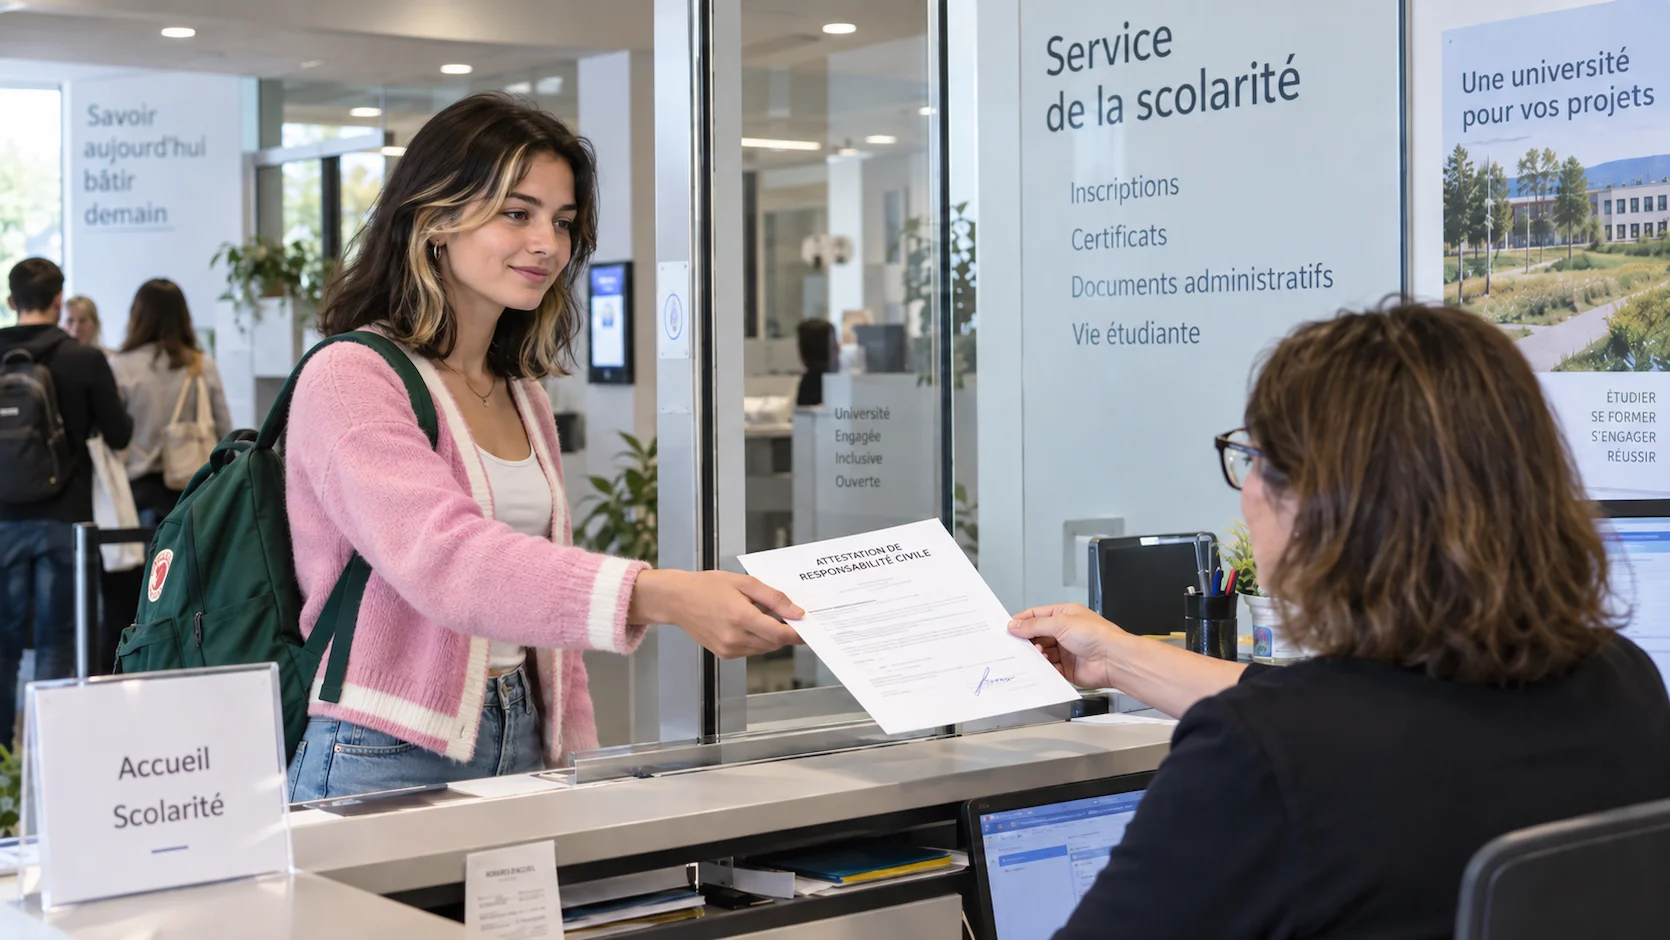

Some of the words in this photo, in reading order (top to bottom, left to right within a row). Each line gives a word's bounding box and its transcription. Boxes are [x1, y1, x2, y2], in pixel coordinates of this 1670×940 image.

[1046, 20, 1173, 77] Service
[1462, 70, 1504, 94] Une
[1512, 46, 1630, 87] université
[1046, 90, 1085, 133] de
[1097, 84, 1124, 127] la
[1136, 53, 1301, 121] scolarité
[86, 101, 158, 127] Savoir
[1463, 104, 1514, 133] pour
[1520, 99, 1560, 121] vos
[1567, 85, 1655, 121] projets
[83, 134, 207, 165] aujourd'hui
[83, 168, 137, 193] bâtir
[1070, 174, 1180, 207] Inscriptions
[83, 201, 169, 226] demain
[1071, 224, 1168, 252] Certificats
[1071, 272, 1179, 299] Documents
[1184, 262, 1334, 295] administratifs
[1072, 322, 1101, 346] Vie
[1106, 320, 1201, 346] étudiante
[1606, 388, 1656, 404] ÉTUDIER
[834, 405, 891, 421] Université
[1591, 410, 1605, 423] SE
[1608, 410, 1656, 424] FORMER
[835, 428, 882, 446] Engagée
[1591, 430, 1656, 443] S'ENGAGER
[835, 451, 884, 465] Inclusive
[1607, 447, 1656, 464] RÉUSSIR
[835, 474, 881, 488] Ouverte
[799, 554, 894, 582] RESPONSABILITÉ
[895, 548, 932, 564] CIVILE
[815, 546, 886, 567] ATTESTATION
[886, 542, 903, 553] DE
[118, 746, 210, 781] Accueil
[113, 791, 225, 830] Scolarité
